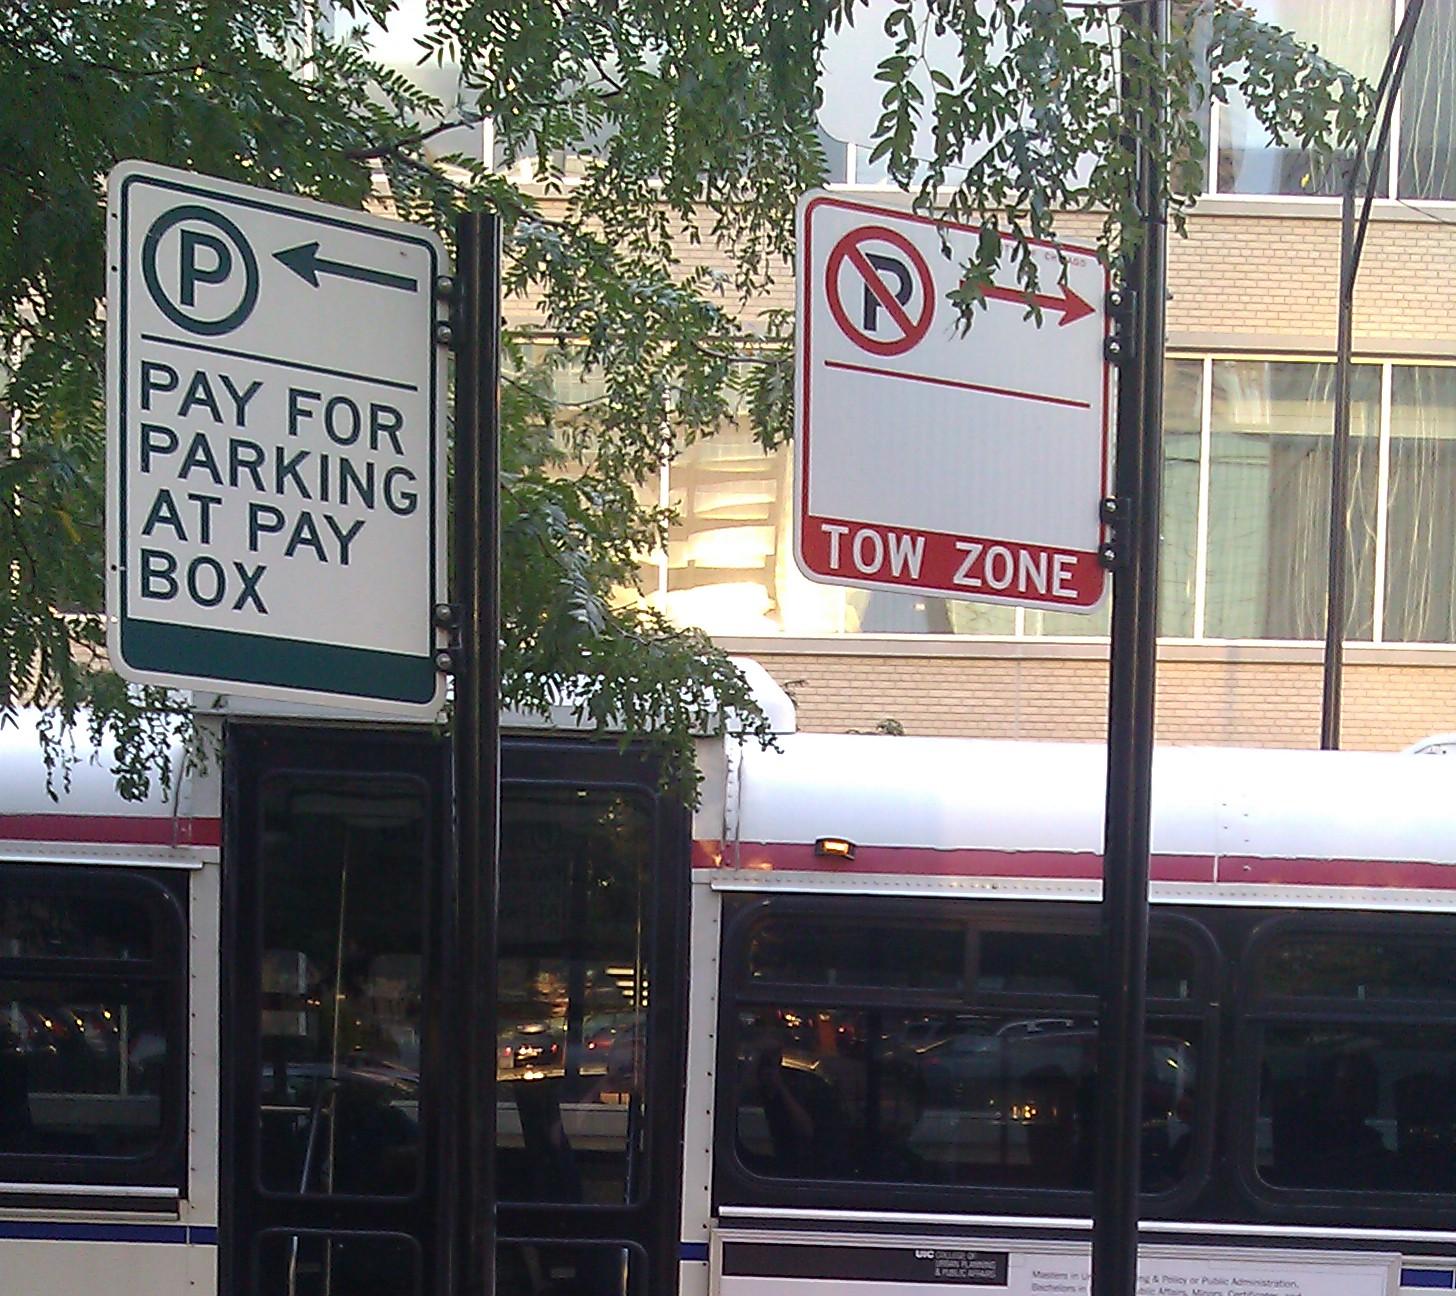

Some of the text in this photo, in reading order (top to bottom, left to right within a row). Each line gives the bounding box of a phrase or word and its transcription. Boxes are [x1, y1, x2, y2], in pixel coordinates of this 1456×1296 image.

[179, 229, 233, 307] P
[863, 253, 913, 332] P
[141, 360, 405, 456] PAY FOR
[141, 422, 418, 516] PARKING
[142, 488, 365, 566] AT PAY
[821, 524, 1079, 598] TOW ZONE
[141, 547, 268, 615] BOX
[915, 1250, 935, 1259] UIC
[1161, 1275, 1187, 1286] Policy
[1188, 1277, 1200, 1285] or
[1201, 1276, 1229, 1286] Public
